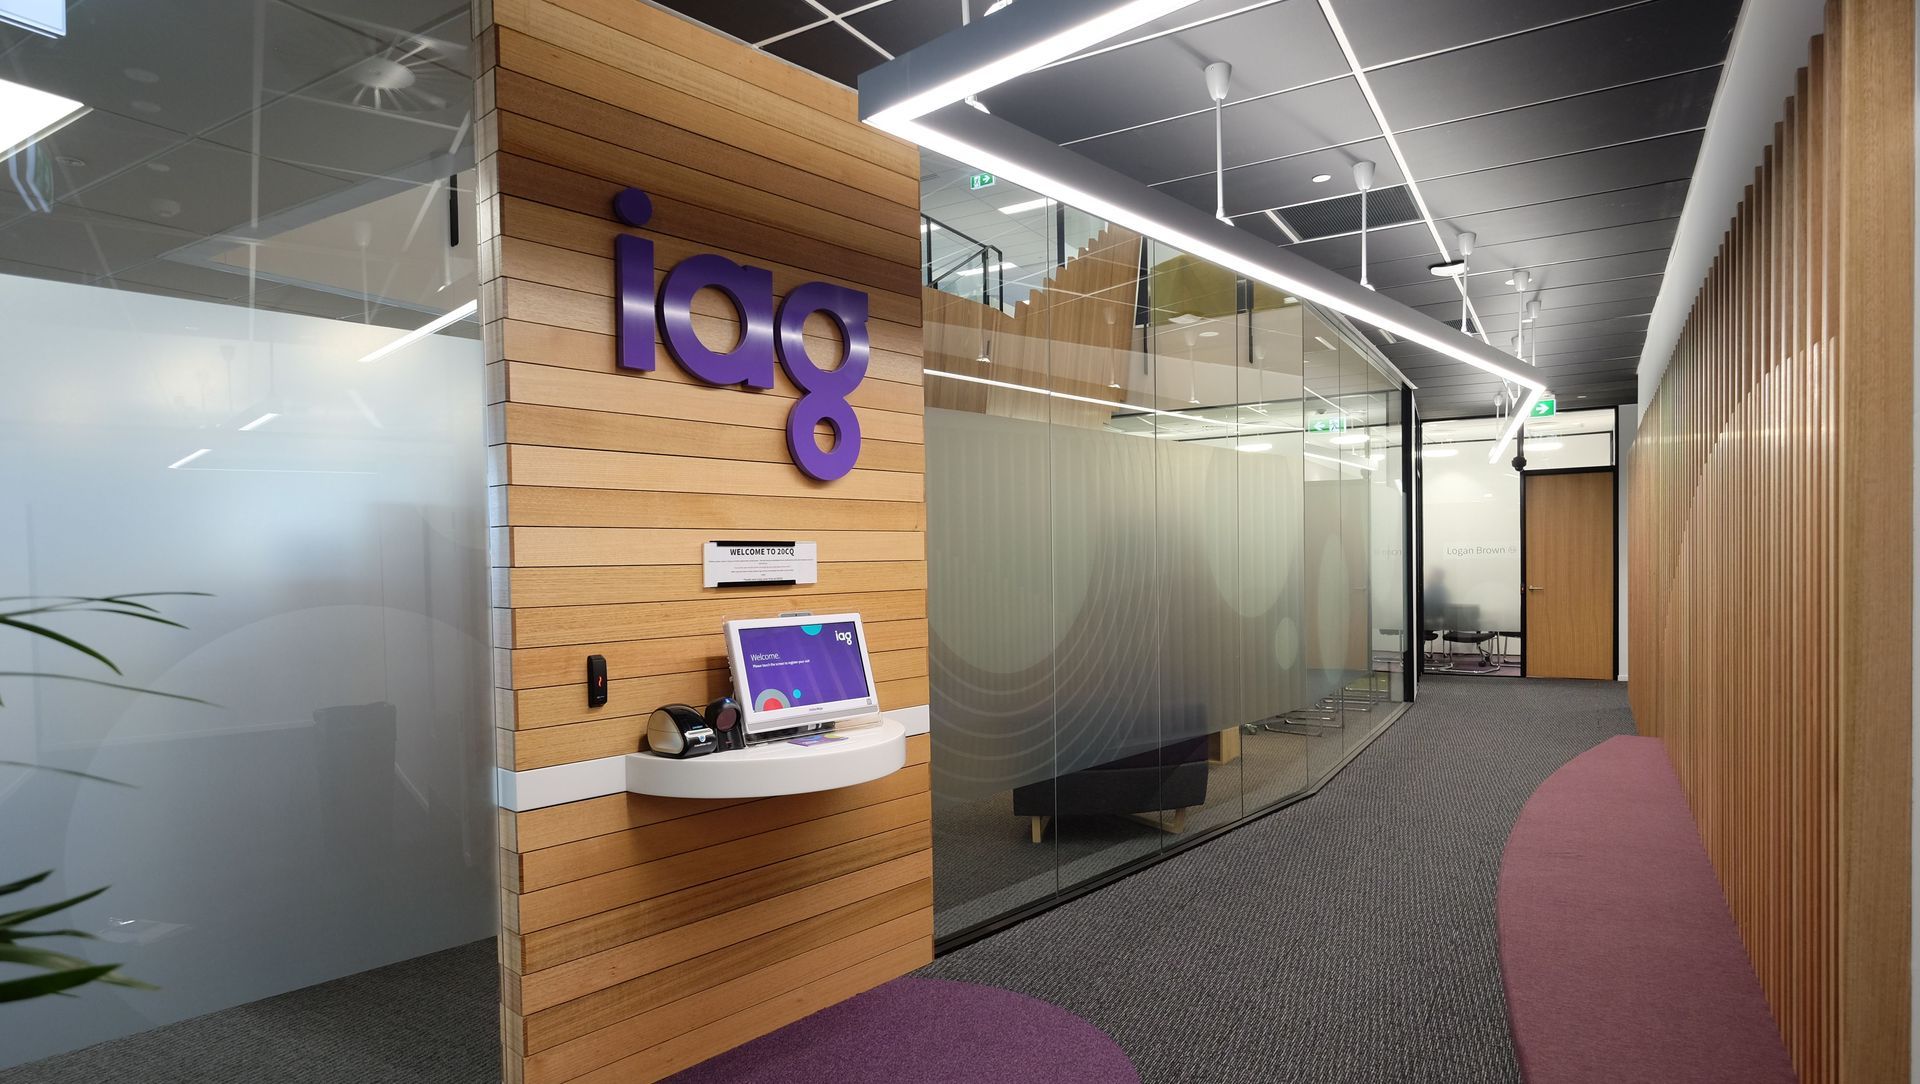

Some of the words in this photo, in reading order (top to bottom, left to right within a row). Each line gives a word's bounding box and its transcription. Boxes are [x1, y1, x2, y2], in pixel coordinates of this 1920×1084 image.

[613, 187, 870, 481] iag
[730, 548, 765, 556] WELCOME
[777, 548, 795, 556] 20CQ
[1447, 547, 1474, 556] Logan
[1476, 546, 1506, 555] Brown
[834, 630, 853, 646] iag
